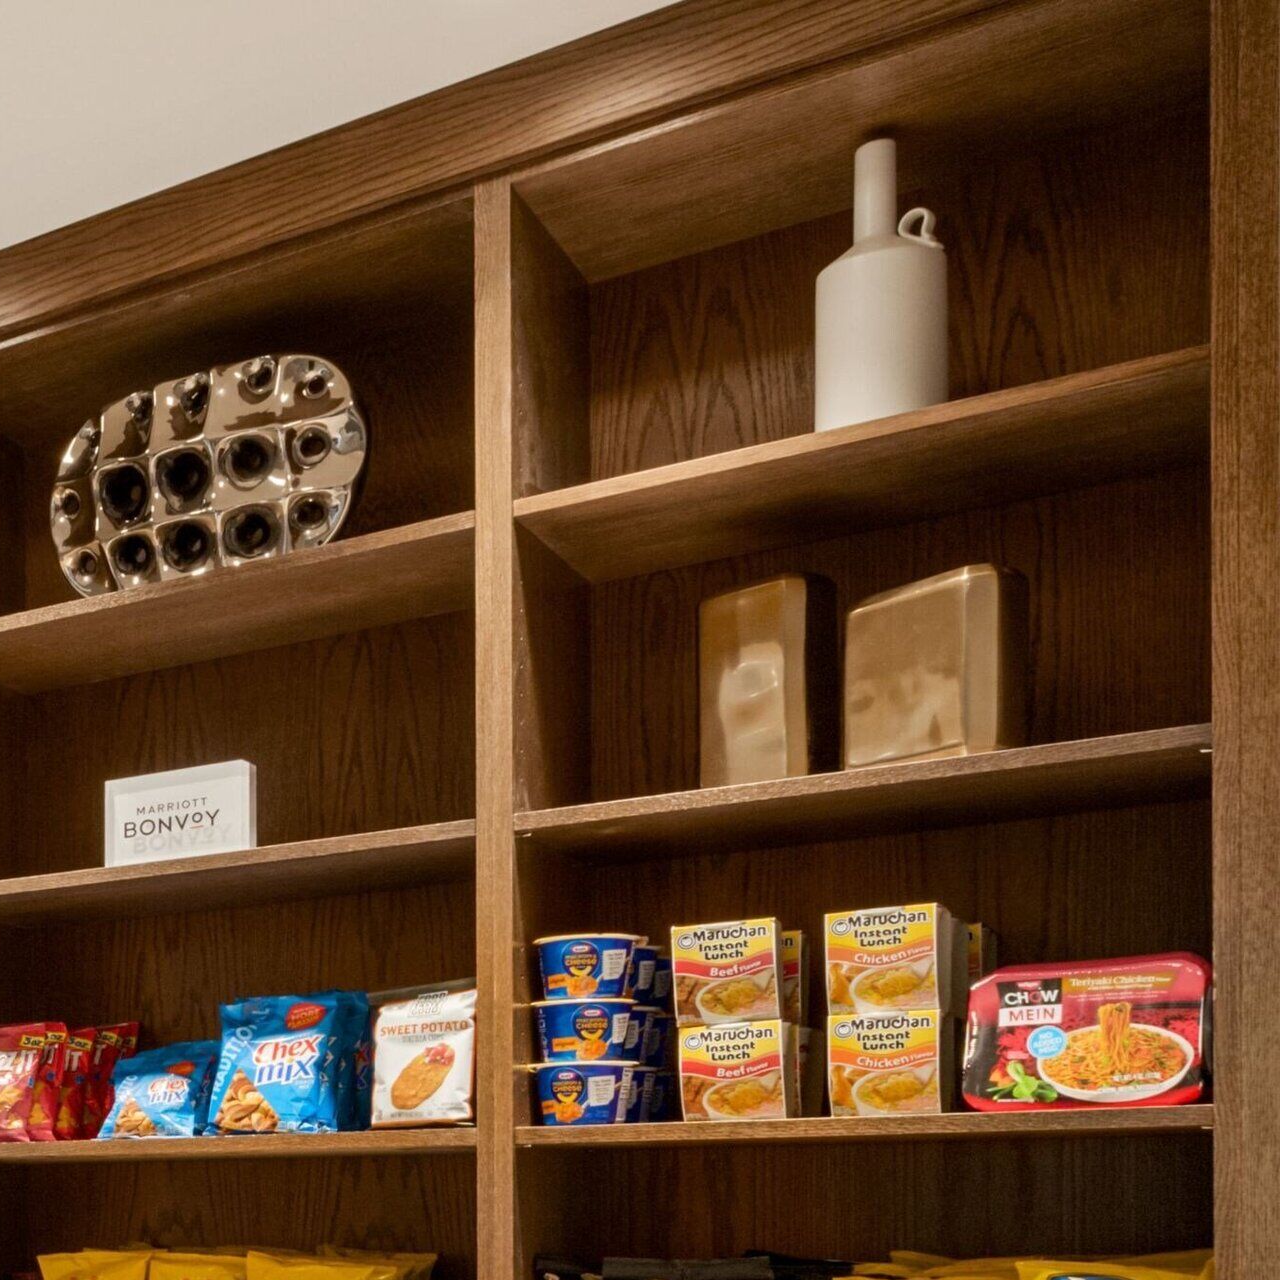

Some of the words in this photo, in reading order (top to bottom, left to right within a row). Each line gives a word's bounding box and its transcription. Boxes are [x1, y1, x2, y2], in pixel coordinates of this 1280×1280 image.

[136, 797, 207, 815] MARRIOTT
[124, 809, 219, 838] BONVOY
[848, 911, 926, 927] Maruchan
[693, 926, 766, 941] Maruchan
[854, 926, 907, 939] Instant
[699, 940, 749, 952] Instant
[860, 936, 901, 947] Lunch
[704, 951, 743, 960] Lunch
[855, 951, 907, 964] Chicken
[710, 965, 739, 976] Beef
[1004, 989, 1059, 1005] CHOW
[1009, 1008, 1055, 1022] MEIN
[381, 1026, 417, 1036] SWEET
[421, 1021, 468, 1032] POTATO
[851, 1017, 930, 1031] Maruchan
[700, 1028, 773, 1042] Maruchan
[857, 1031, 910, 1042] Instant
[254, 1035, 322, 1063] Chex
[706, 1042, 755, 1053] Instant
[863, 1041, 904, 1050] Lunch
[712, 1052, 750, 1061] Lunch
[857, 1055, 910, 1069] Chicken
[256, 1057, 313, 1085] mix
[717, 1066, 746, 1078] Beef
